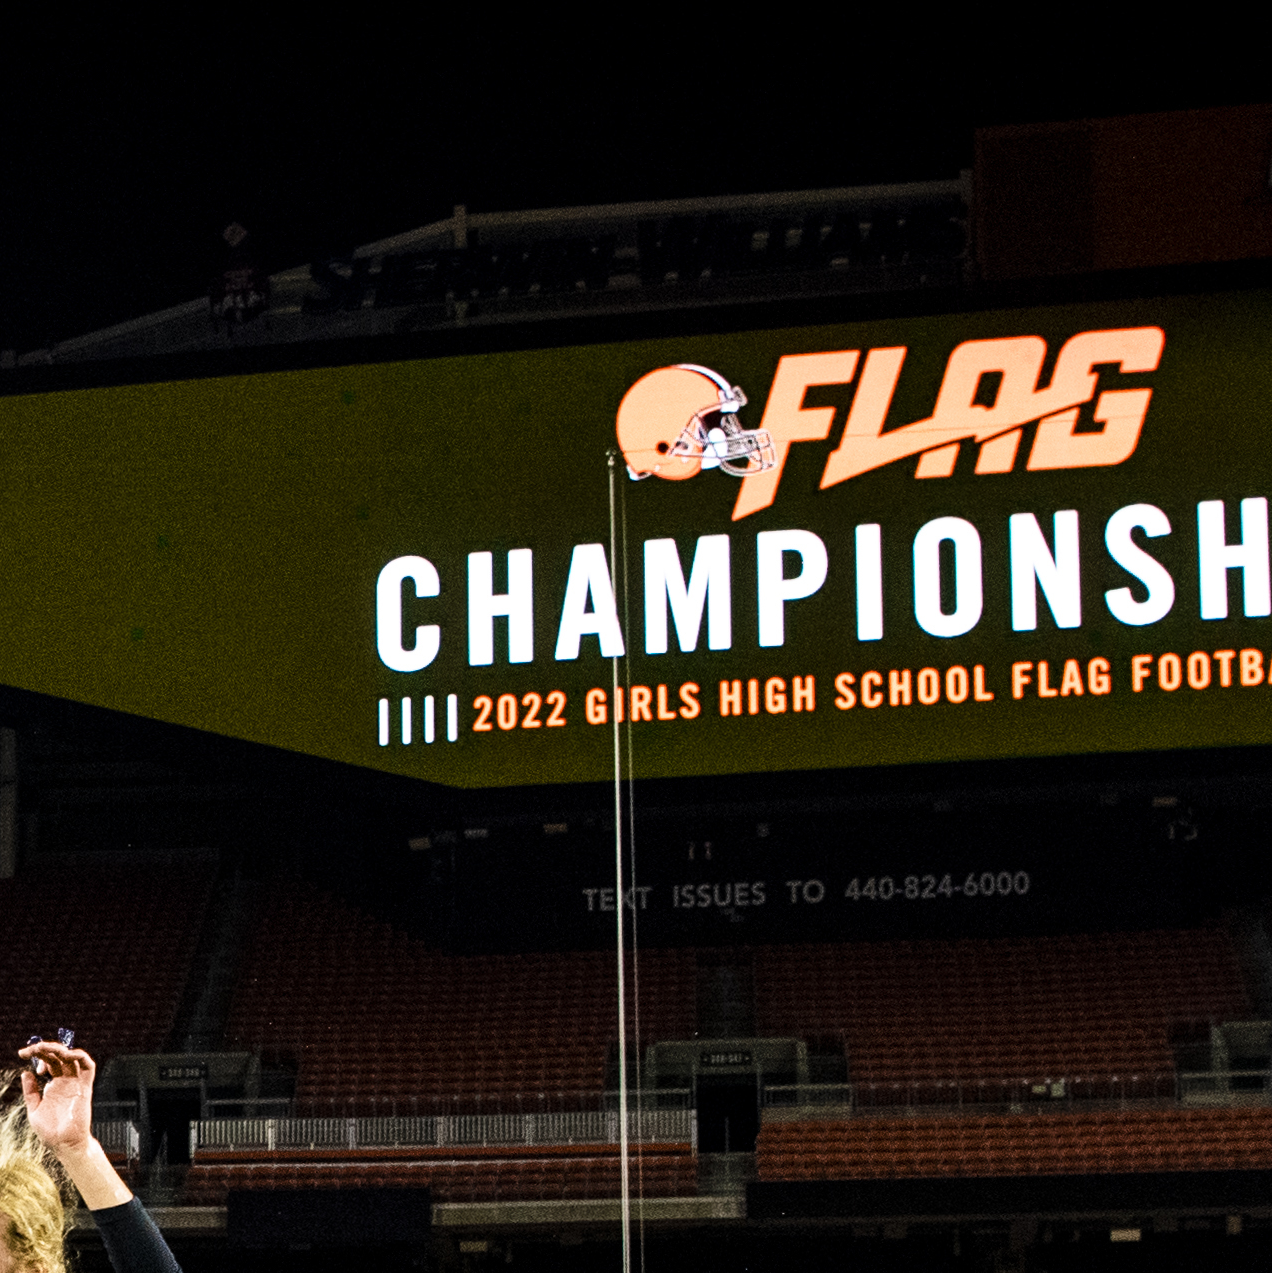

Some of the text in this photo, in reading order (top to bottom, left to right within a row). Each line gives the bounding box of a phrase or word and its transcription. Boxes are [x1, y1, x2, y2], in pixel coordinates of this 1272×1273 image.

[731, 325, 1167, 521] FLAG
[472, 689, 568, 732] 2022
[585, 681, 702, 726] GIRLS
[718, 674, 817, 717] HIGH
[833, 663, 993, 710] SCHOOL
[1011, 656, 1113, 700] FLAG
[581, 869, 1032, 912] TEXT ISSUES TO 440-824-6000
